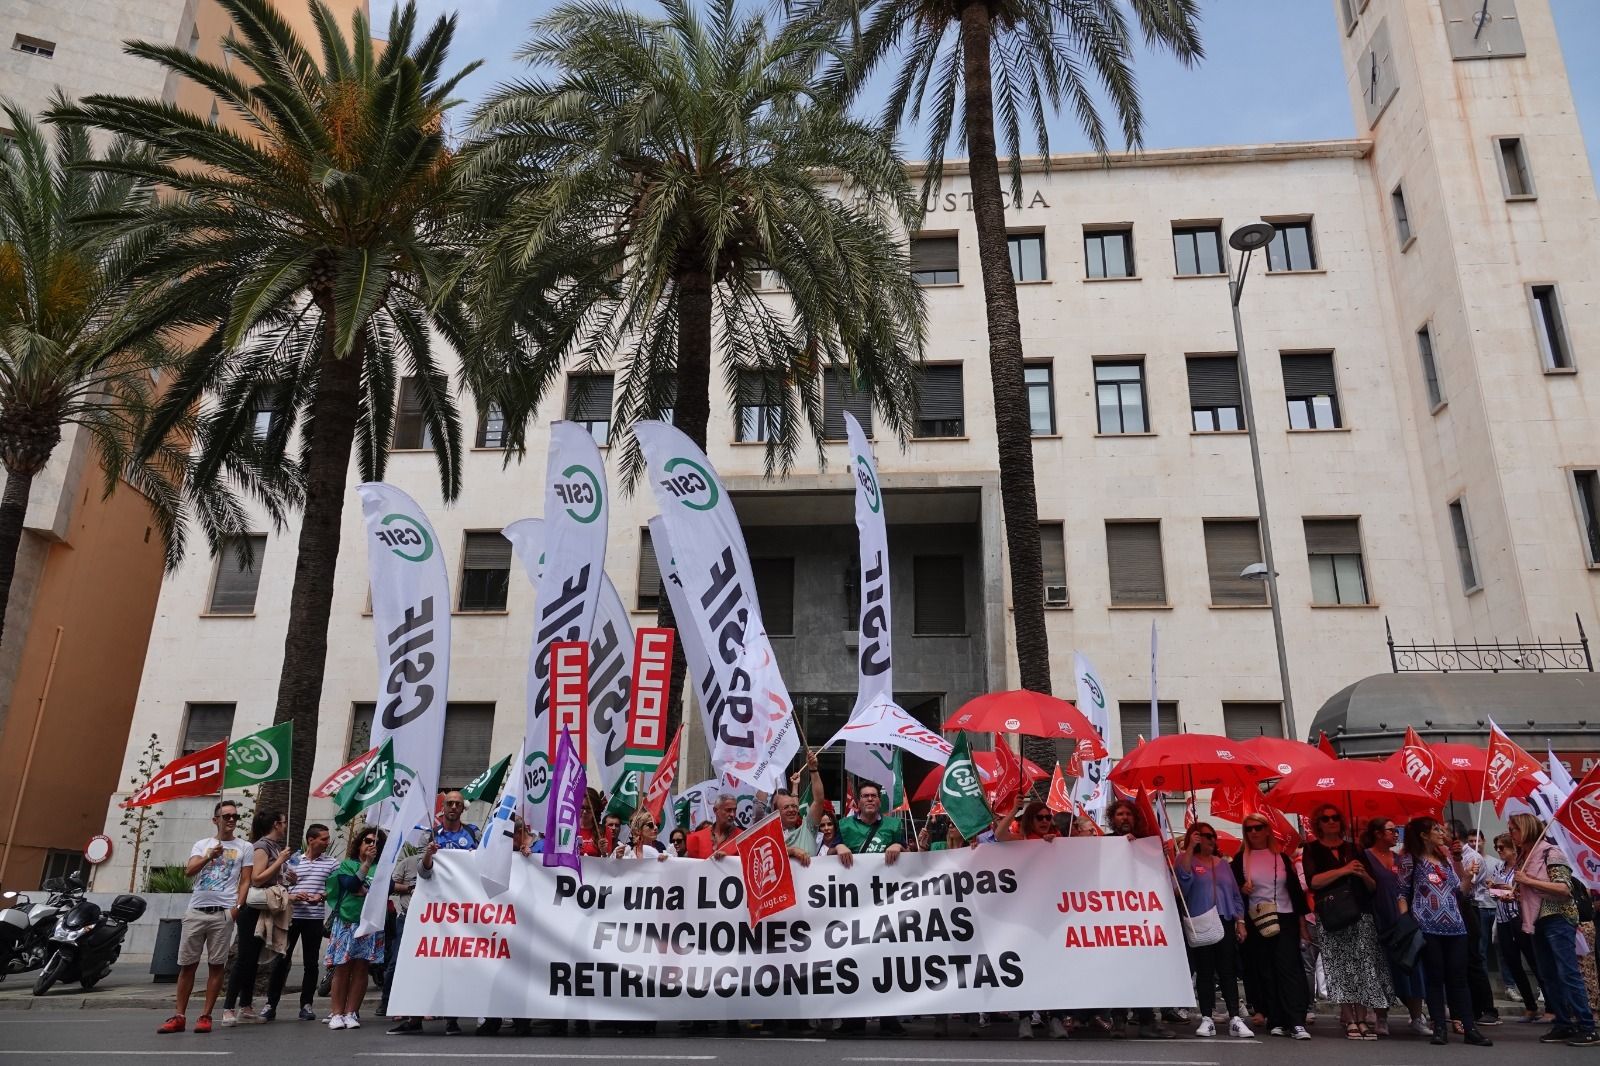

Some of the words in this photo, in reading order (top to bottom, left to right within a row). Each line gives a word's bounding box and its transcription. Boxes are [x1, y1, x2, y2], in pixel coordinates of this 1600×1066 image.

[633, 634, 667, 745] CCOO
[367, 760, 389, 783] SIF
[952, 768, 981, 797] CSIF
[553, 875, 613, 910] Por
[624, 885, 685, 911] una
[808, 875, 859, 909] sin
[870, 868, 1018, 904] trampas
[1057, 890, 1164, 913] JUSTICIA
[420, 902, 517, 925] JUSTICIA
[593, 919, 812, 955] FUNCIONES
[824, 906, 975, 949] CLARAS
[1065, 920, 1168, 948] ALMERÍA
[416, 932, 512, 960] ALMERÍA
[549, 956, 860, 999] RETRIBUCIONES
[872, 950, 1024, 995] JUSTAS
